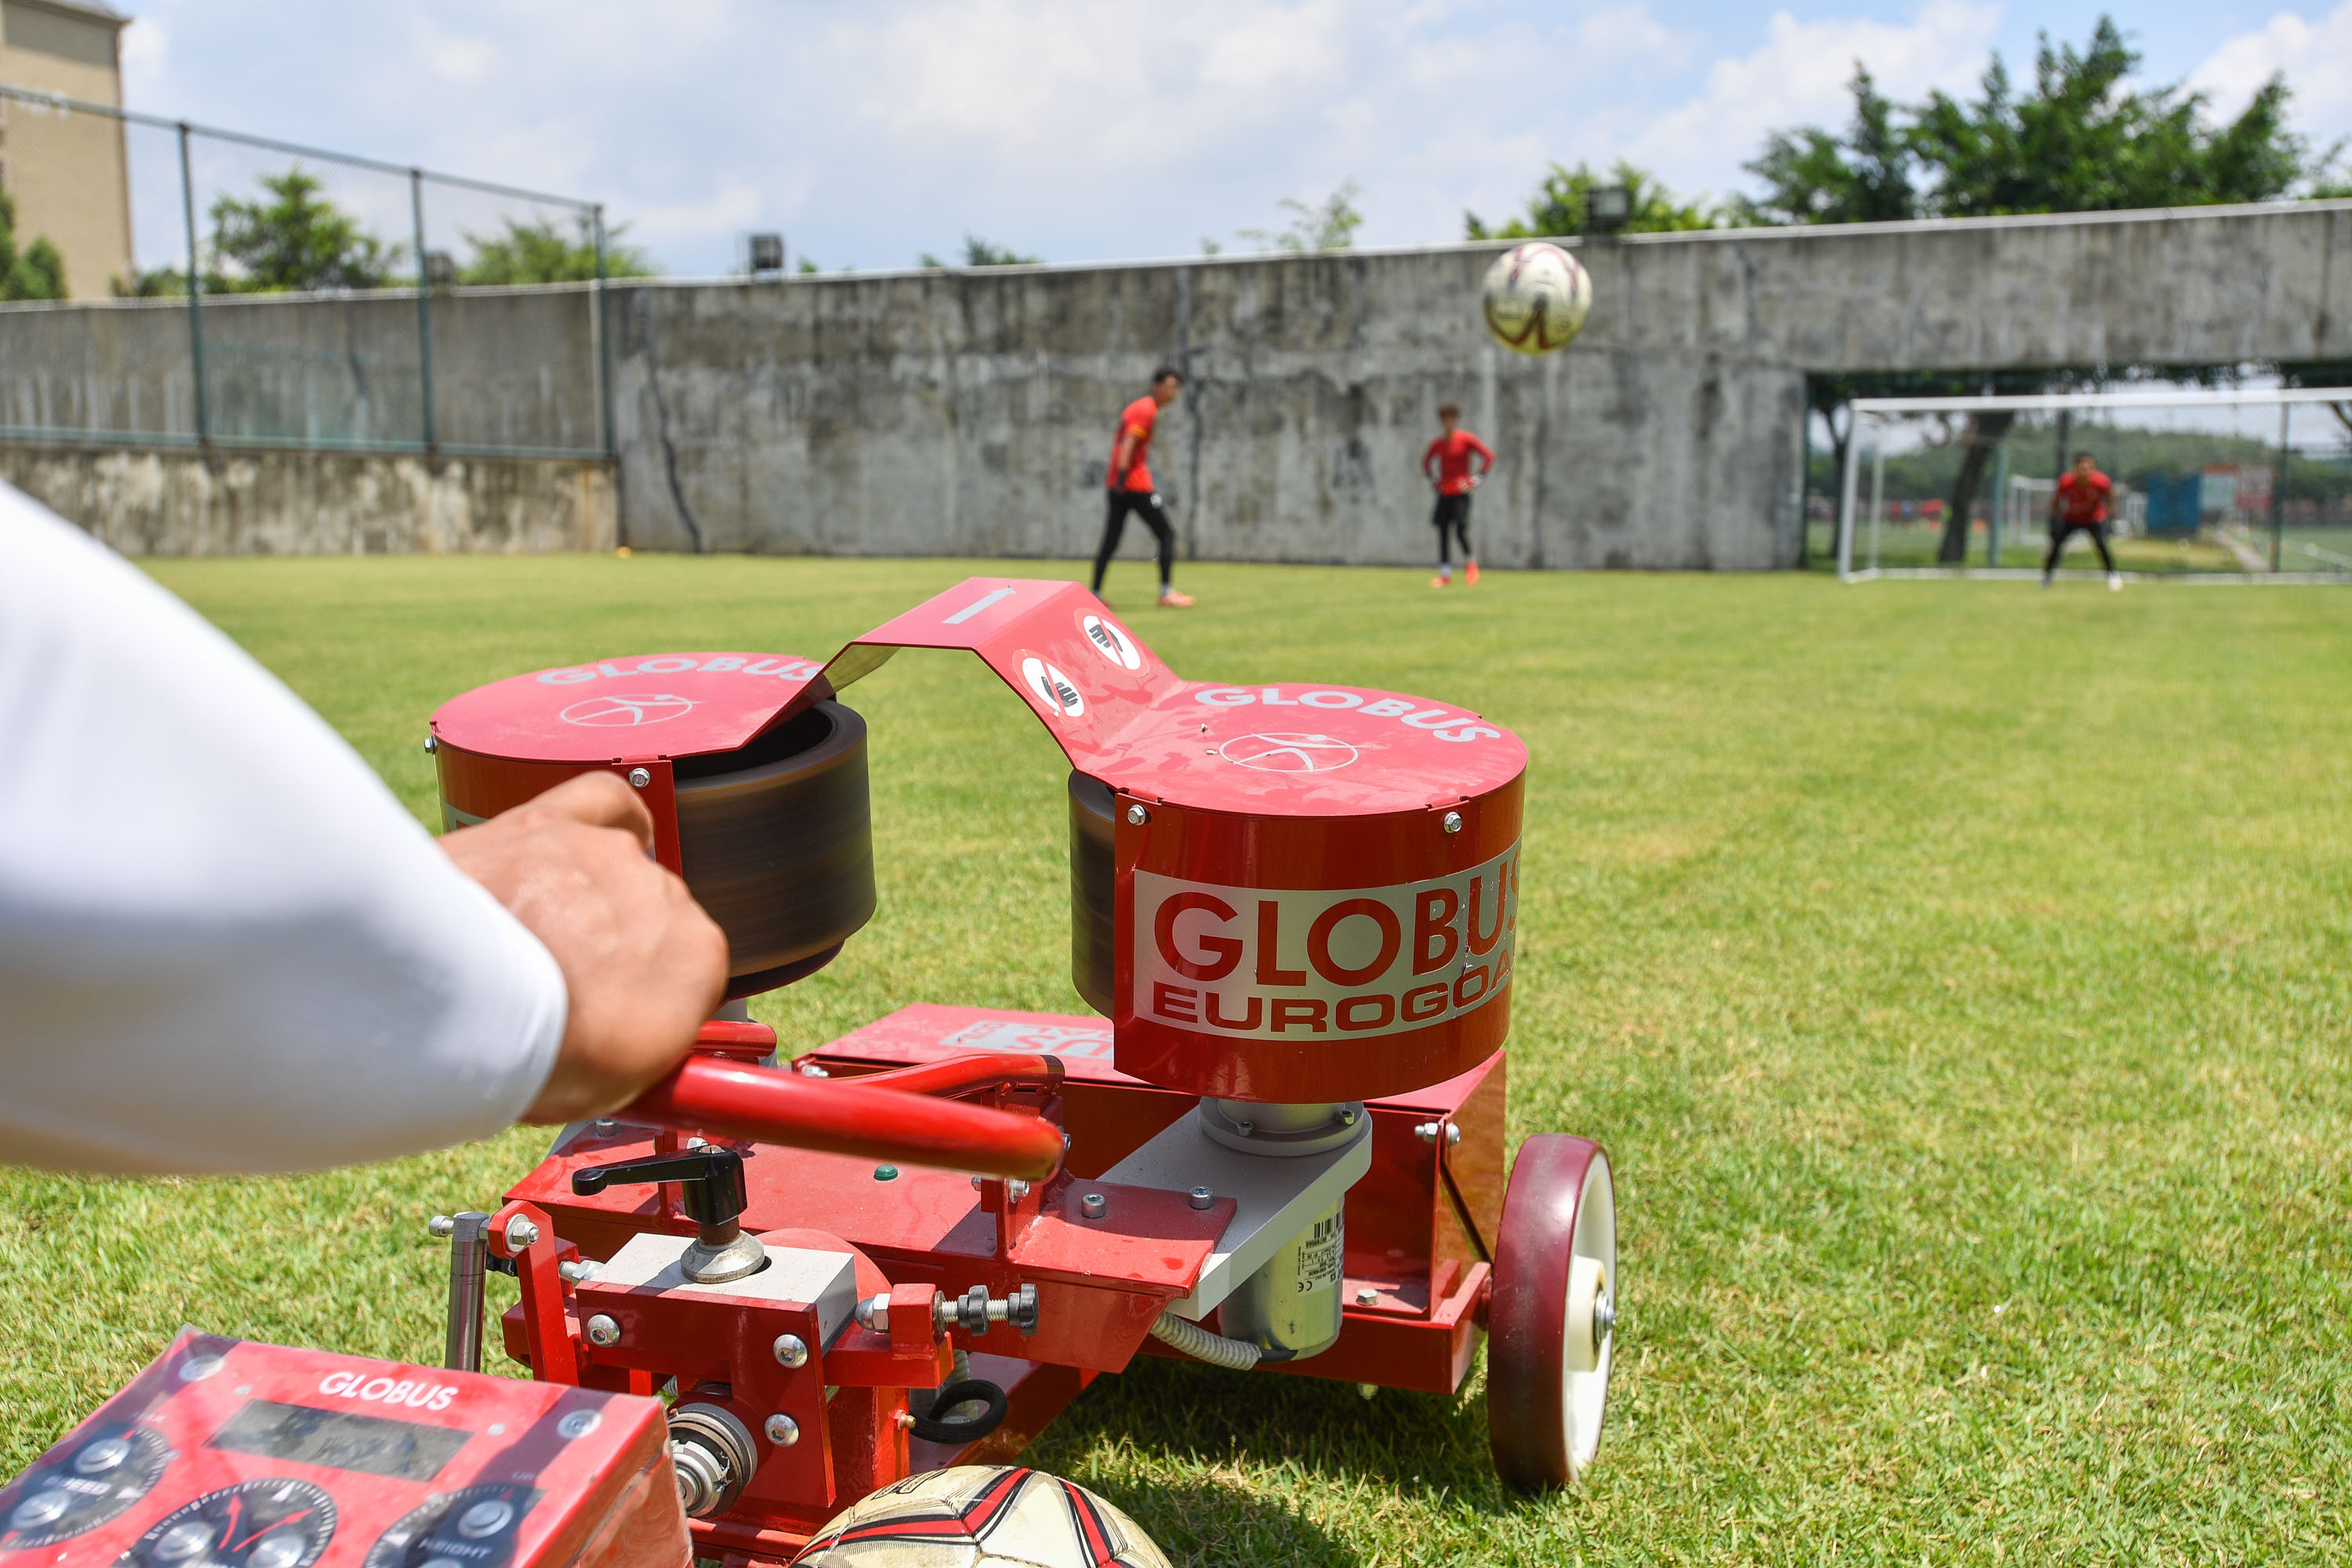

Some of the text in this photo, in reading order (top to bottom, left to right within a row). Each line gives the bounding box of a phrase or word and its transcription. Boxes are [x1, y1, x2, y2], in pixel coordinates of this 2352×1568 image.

[536, 657, 824, 685] GLOBUS
[1195, 688, 1501, 743] GLOBUS
[1153, 943, 1515, 1033] EUROGOA
[319, 1371, 459, 1411] GLOBUS
[417, 1538, 492, 1559] HEIGHT
